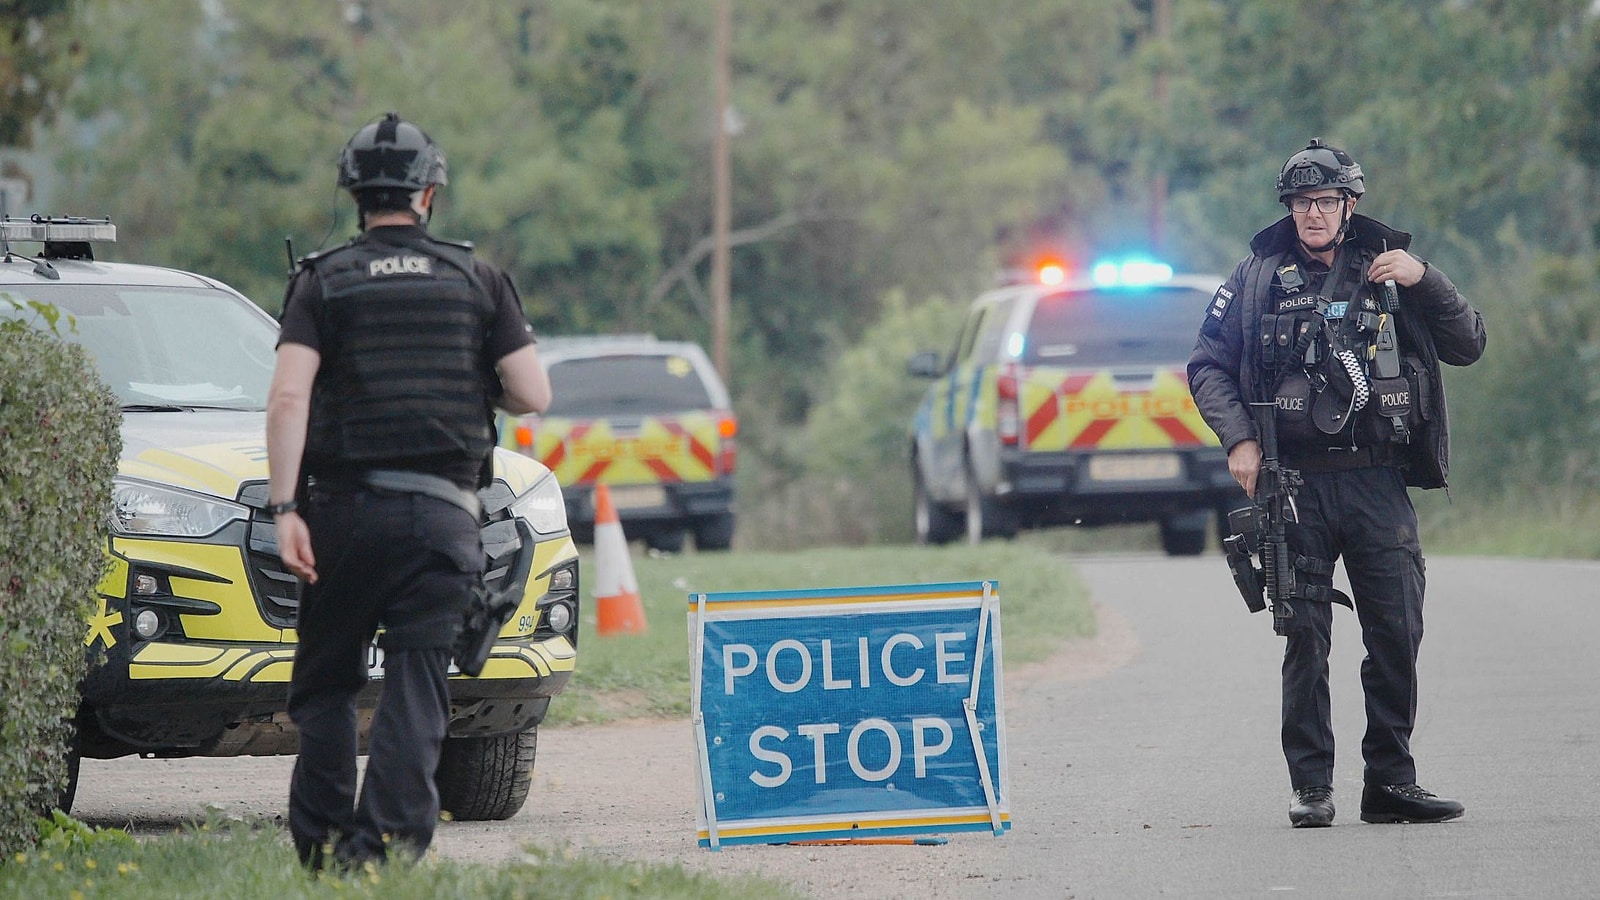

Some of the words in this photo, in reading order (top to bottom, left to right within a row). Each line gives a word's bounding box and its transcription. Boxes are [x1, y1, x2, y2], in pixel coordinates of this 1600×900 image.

[370, 255, 431, 276] POLICE
[1279, 296, 1314, 310] POLICE
[1328, 304, 1346, 317] ICE
[1275, 397, 1304, 411] POLICE
[1381, 391, 1409, 407] POLICE
[722, 632, 970, 695] POLICE
[748, 718, 954, 787] STOP
